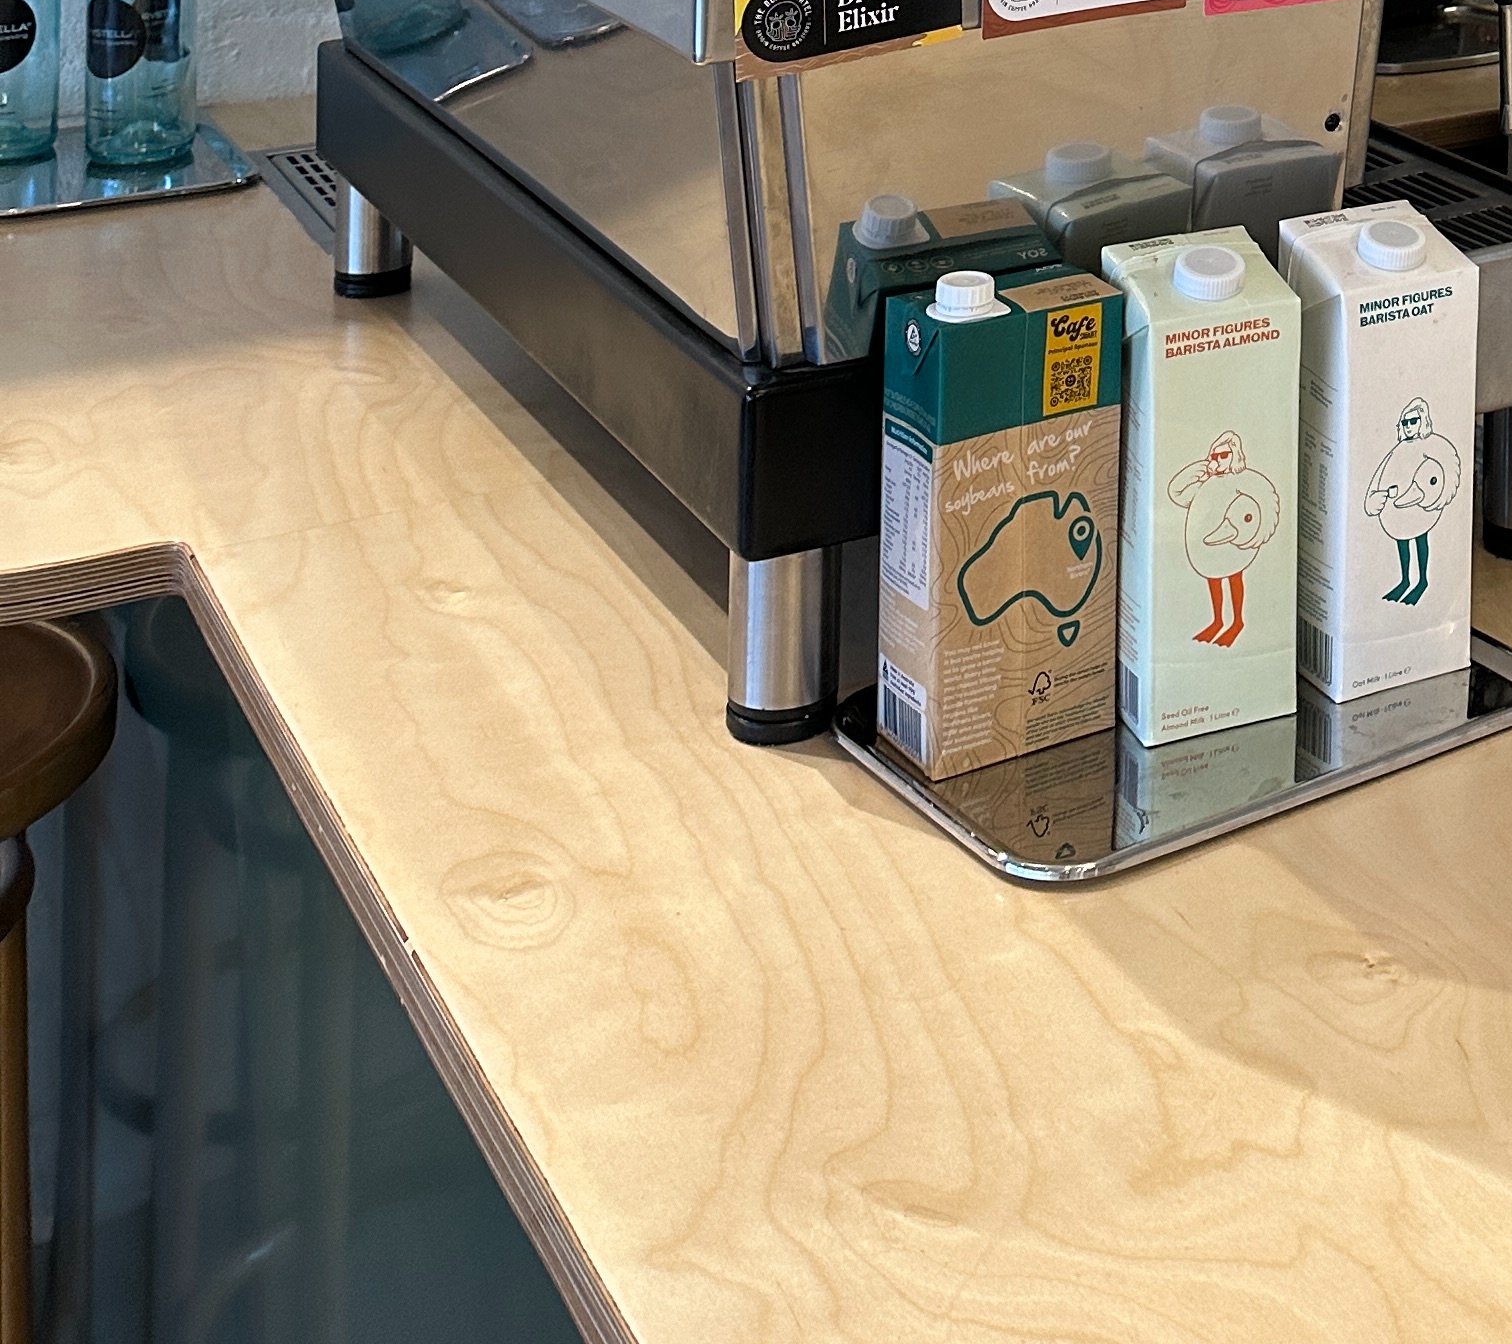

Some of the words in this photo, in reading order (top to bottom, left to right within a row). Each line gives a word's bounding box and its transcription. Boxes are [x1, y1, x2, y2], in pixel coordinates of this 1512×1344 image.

[753, 8, 766, 25] THE
[838, 2, 900, 33] Elixir
[1360, 296, 1400, 315] MINOR
[1402, 286, 1453, 306] FIGURES
[1050, 314, 1097, 342] Cafe
[1360, 308, 1411, 327] BARISTA
[1412, 303, 1435, 317] OAT
[1165, 328, 1211, 346] MINOR
[1213, 317, 1271, 337] FIGURES
[1165, 339, 1221, 359] BARISTA
[1223, 329, 1281, 348] ALMOND
[953, 450, 1015, 481] Where
[1027, 433, 1061, 455] are
[1065, 420, 1093, 442] our
[944, 480, 1015, 516] soybeans
[1026, 445, 1081, 485] from?
[1031, 694, 1051, 706] FSC
[1161, 712, 1180, 721] Seed
[1193, 705, 1209, 714] Free
[1161, 720, 1189, 732] Almond
